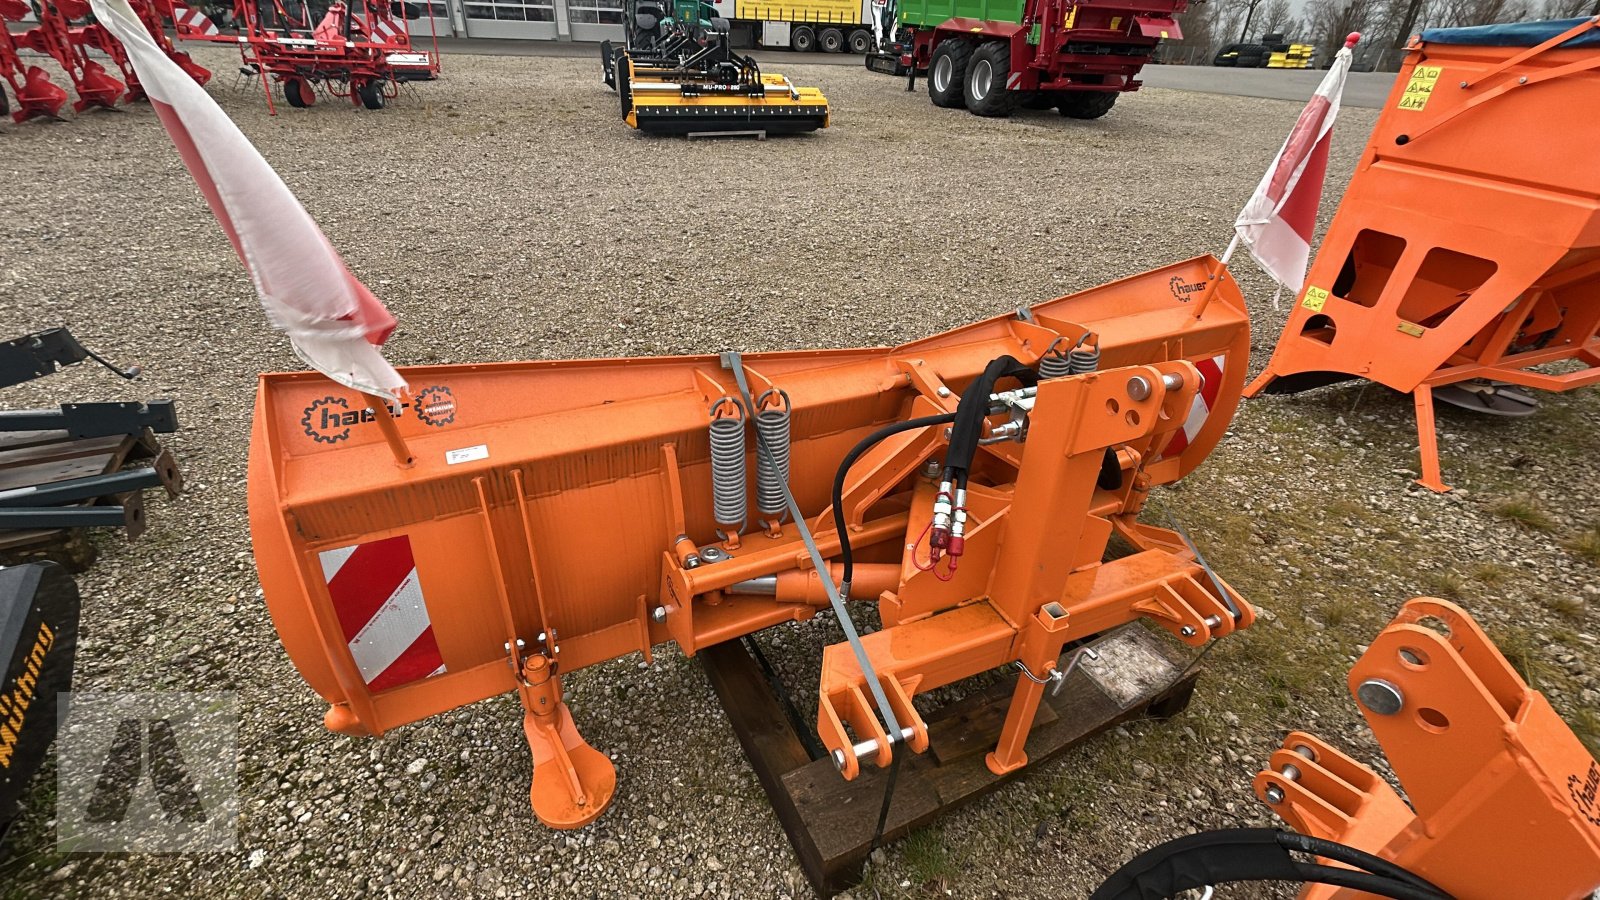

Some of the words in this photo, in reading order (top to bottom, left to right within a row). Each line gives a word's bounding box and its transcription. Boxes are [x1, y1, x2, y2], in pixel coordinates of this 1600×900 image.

[1175, 281, 1207, 295] hauer
[425, 403, 454, 413] PREMIUM
[1575, 759, 1600, 812] hauer
